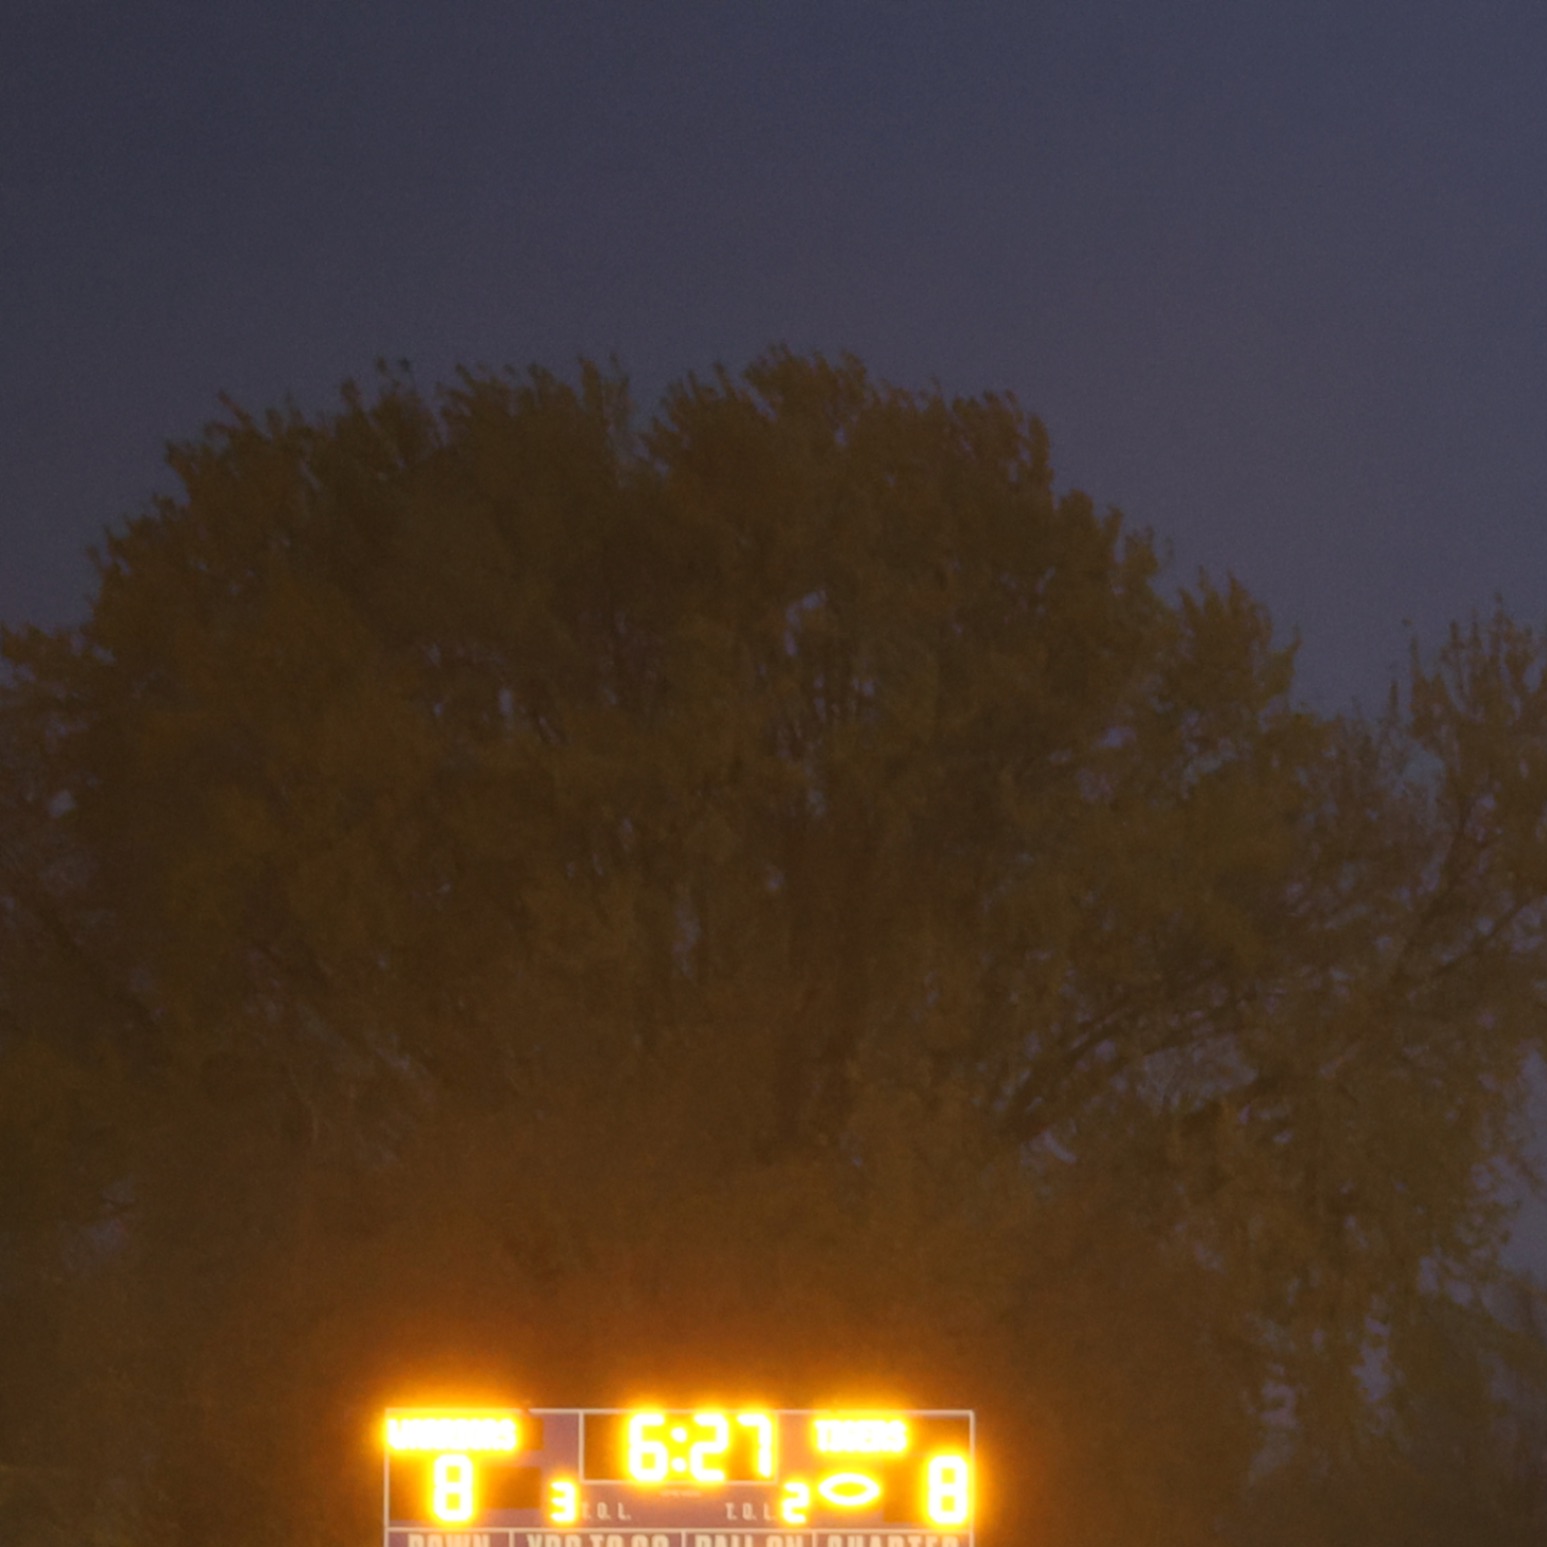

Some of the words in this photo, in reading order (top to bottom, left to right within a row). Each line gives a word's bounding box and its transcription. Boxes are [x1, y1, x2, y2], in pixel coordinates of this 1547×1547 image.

[628, 1411, 772, 1483] 6:27
[434, 1452, 474, 1523] 8
[549, 1480, 577, 1523] 3
[782, 1481, 810, 1525] 2
[928, 1453, 969, 1525] 8
